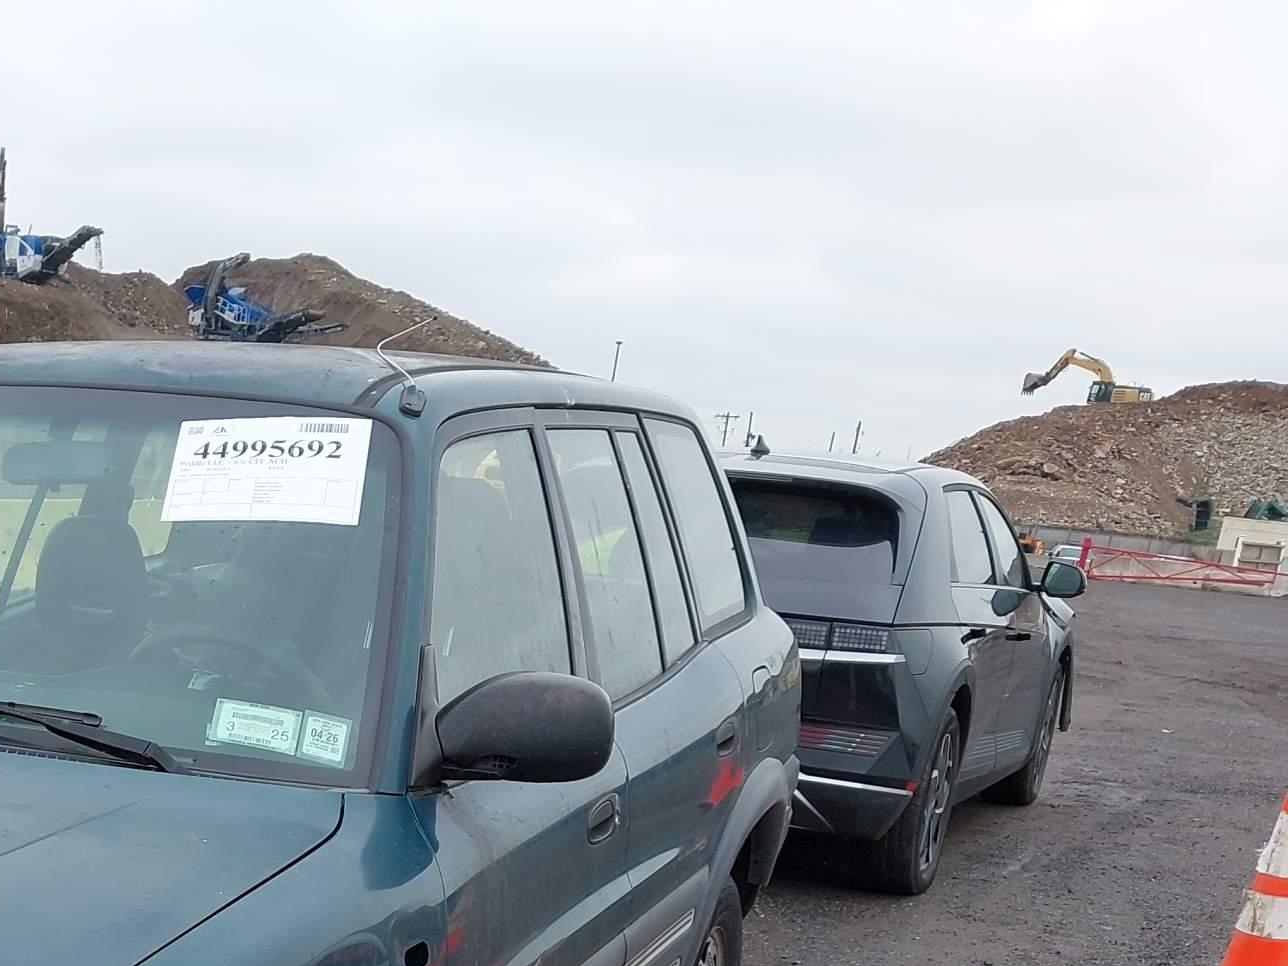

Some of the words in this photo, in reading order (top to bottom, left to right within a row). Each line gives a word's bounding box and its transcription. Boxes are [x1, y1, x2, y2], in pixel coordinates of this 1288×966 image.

[1139, 391, 1151, 401] CAT
[193, 439, 343, 459] 44995692
[225, 721, 236, 732] 3
[270, 729, 290, 742] 25
